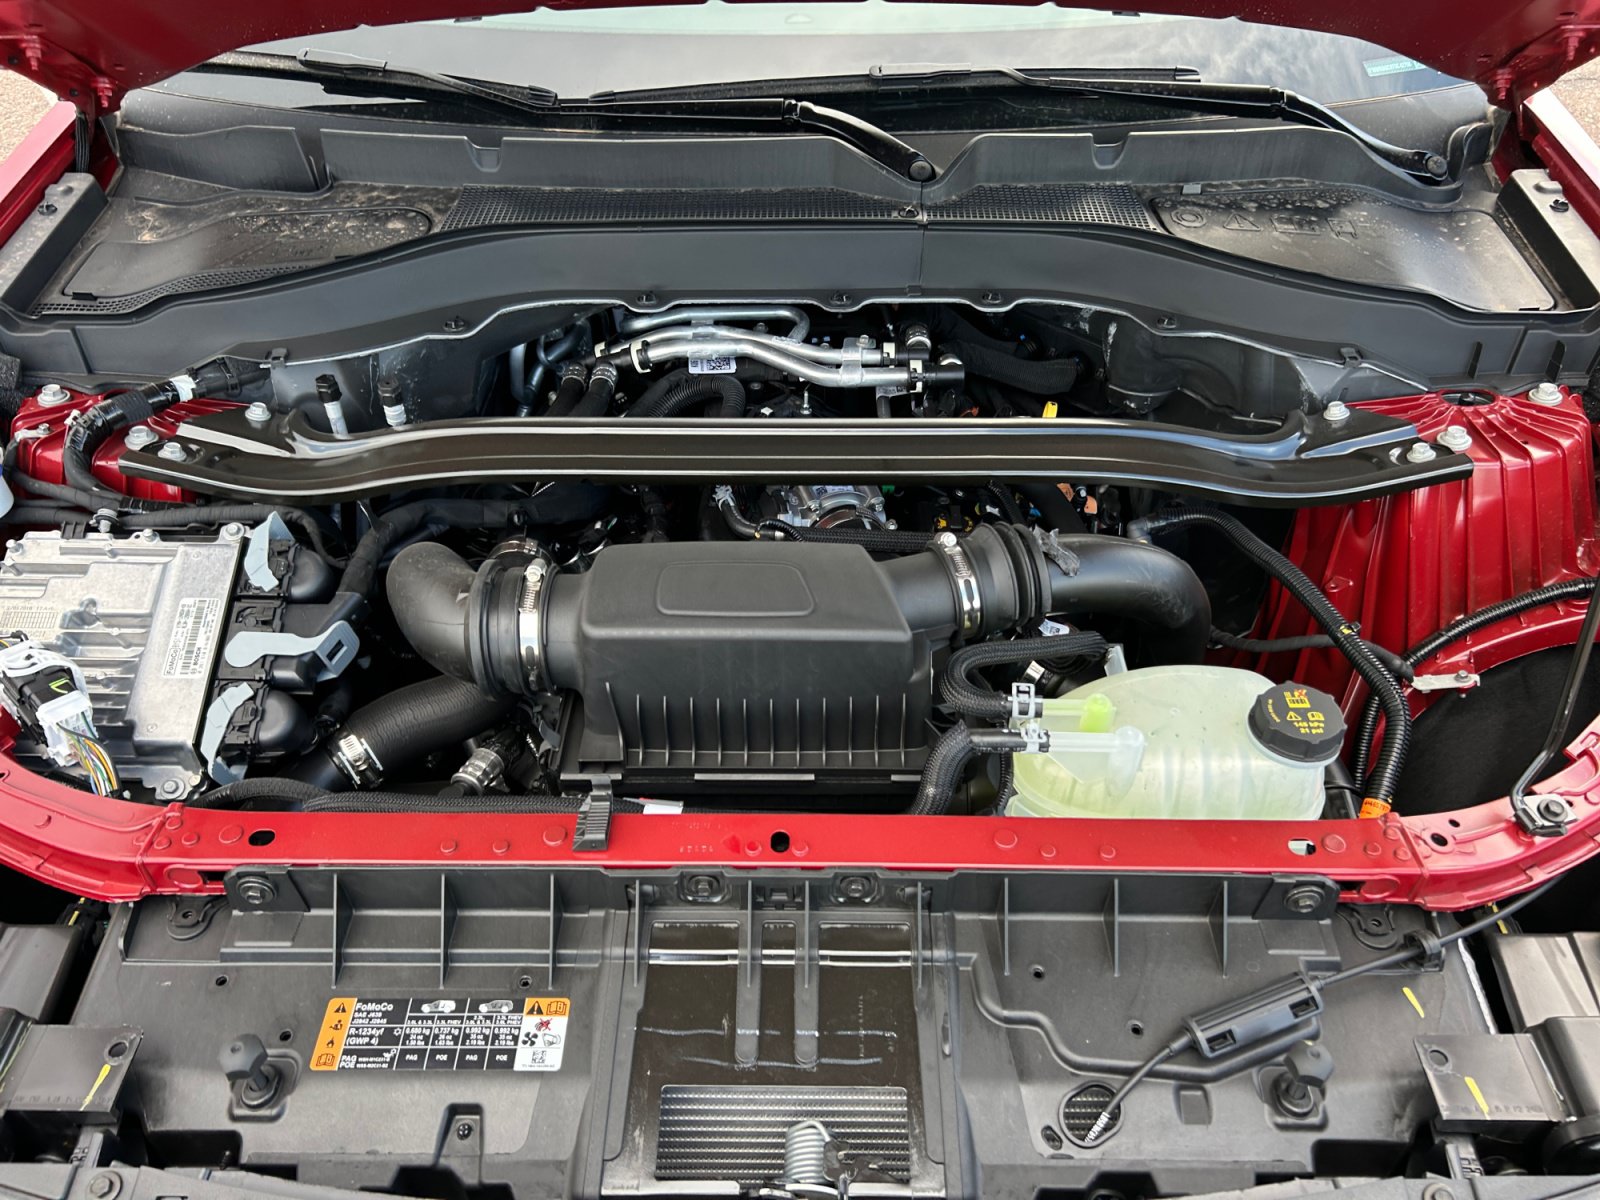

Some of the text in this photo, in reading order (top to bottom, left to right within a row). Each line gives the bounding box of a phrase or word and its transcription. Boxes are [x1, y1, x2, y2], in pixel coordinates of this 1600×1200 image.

[193, 646, 201, 666] BOSCH
[166, 649, 178, 674] FoMoCo
[355, 1002, 394, 1011] FoMoCo
[348, 1027, 385, 1037] R-1234yf
[422, 1027, 431, 1035] kg
[451, 1027, 460, 1035] kg
[482, 1027, 490, 1035] kg
[511, 1027, 519, 1035] kg
[345, 1036, 379, 1046] (GWP 4)
[341, 1054, 357, 1062] PAG
[339, 1061, 356, 1069] POE
